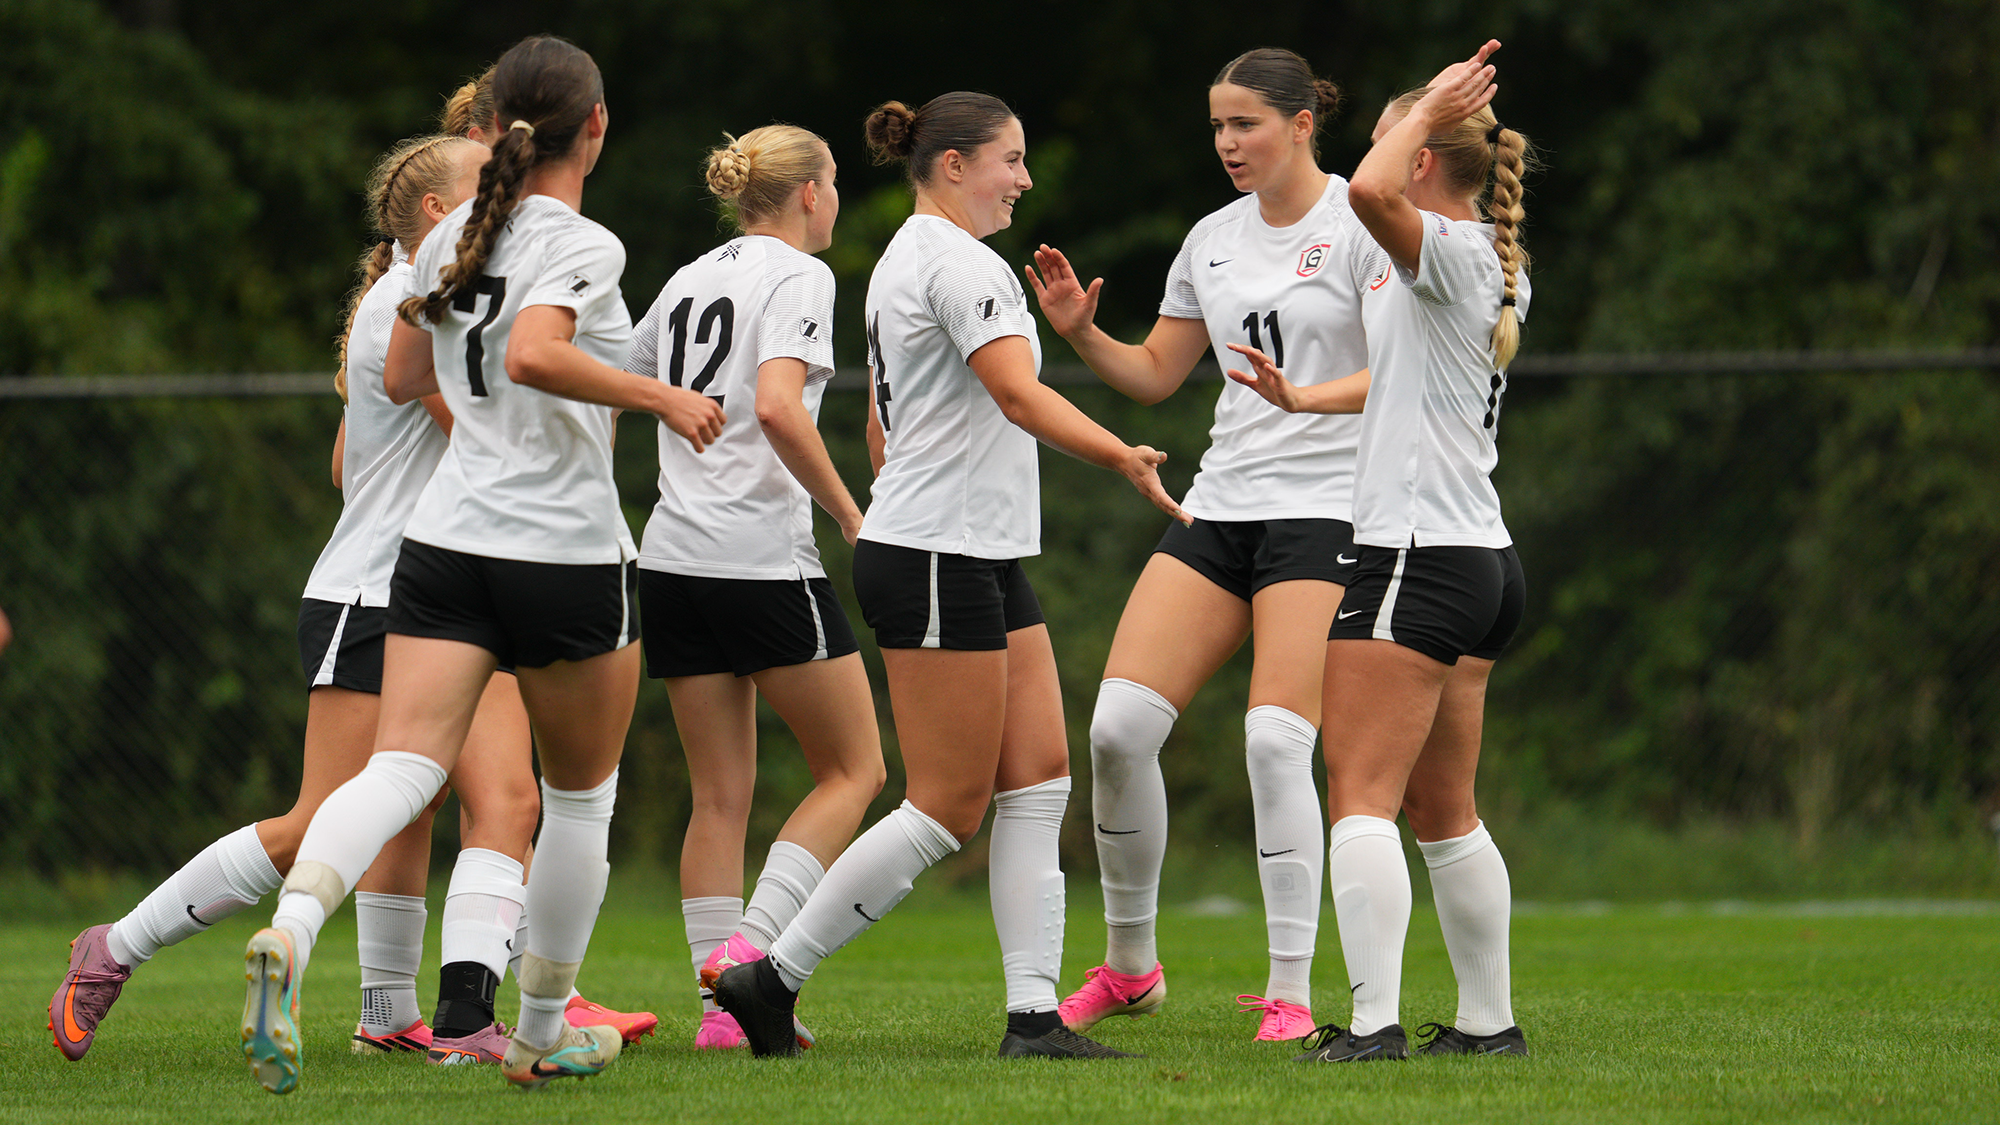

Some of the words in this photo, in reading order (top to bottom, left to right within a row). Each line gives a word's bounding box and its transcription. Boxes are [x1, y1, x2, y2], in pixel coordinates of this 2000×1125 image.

[453, 274, 507, 397] 7
[668, 296, 734, 409] 12
[1242, 309, 1284, 369] 11
